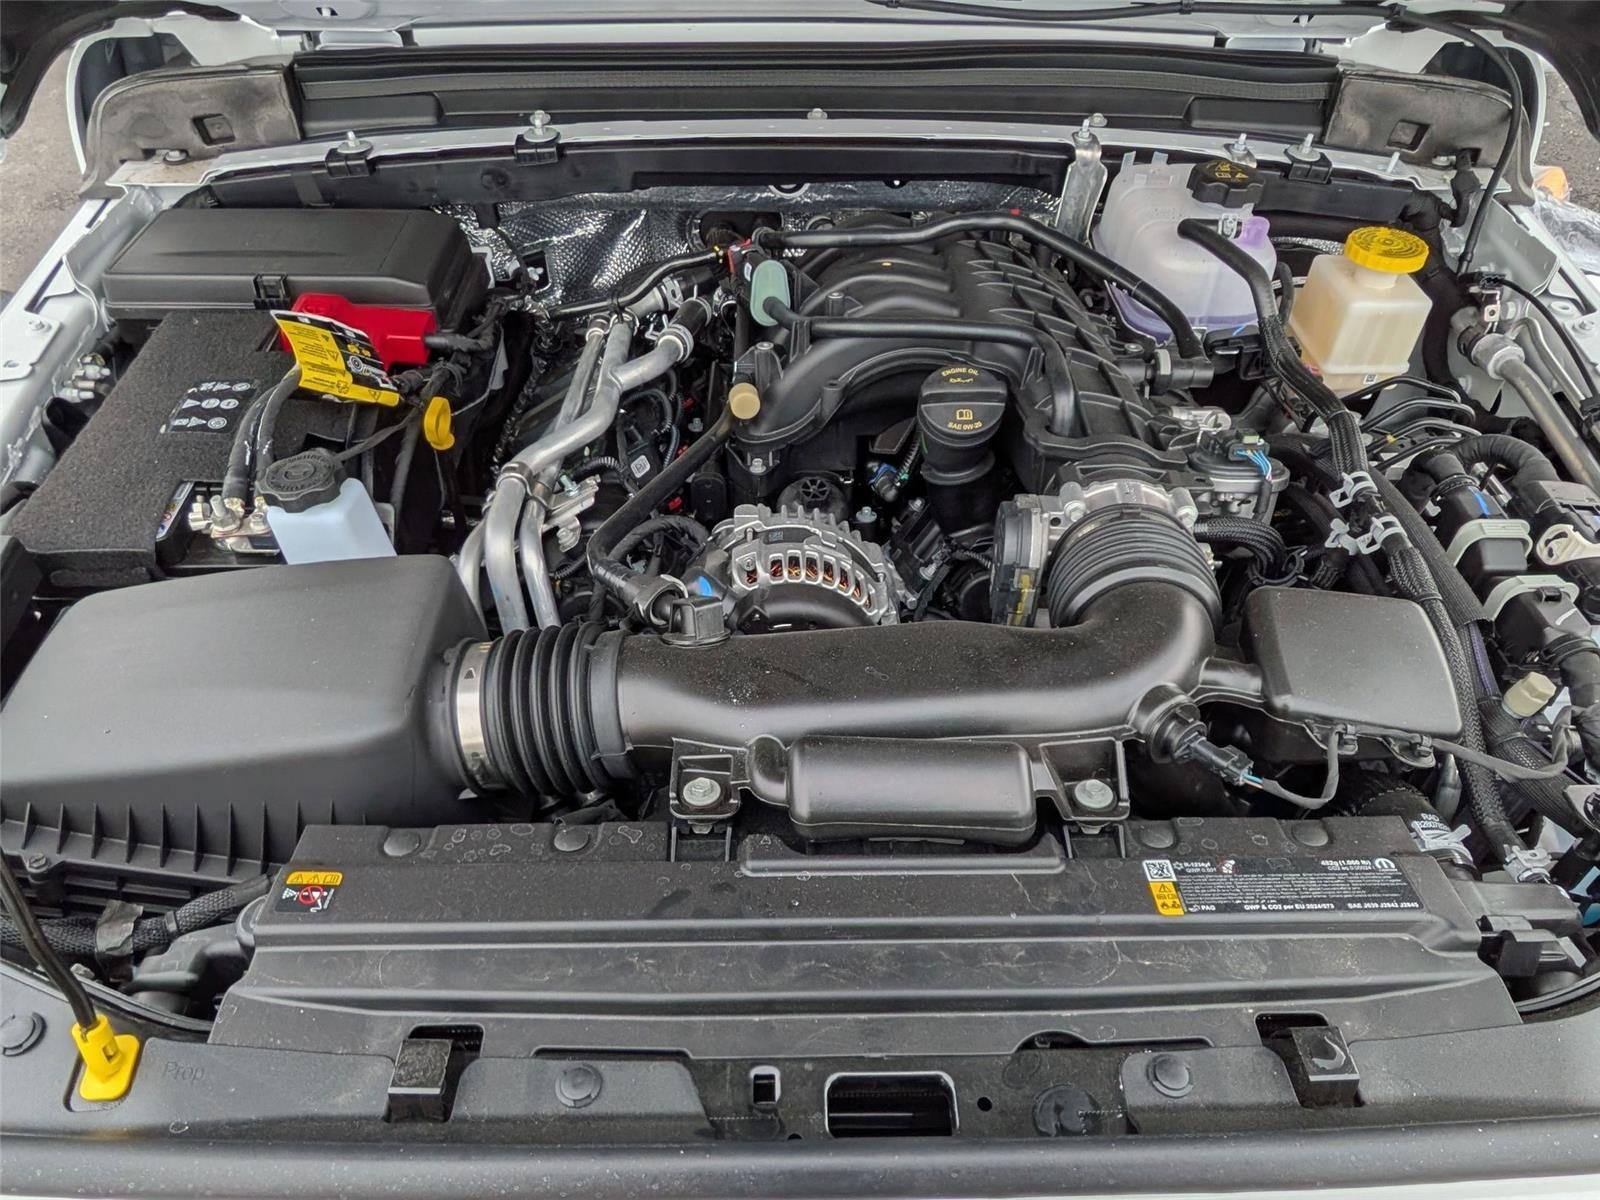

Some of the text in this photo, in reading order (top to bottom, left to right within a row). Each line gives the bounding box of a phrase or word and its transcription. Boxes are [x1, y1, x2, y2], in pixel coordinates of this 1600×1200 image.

[941, 367, 980, 377] ENGINE OIL
[1420, 813, 1440, 822] RAD
[162, 1061, 205, 1085] Prop
